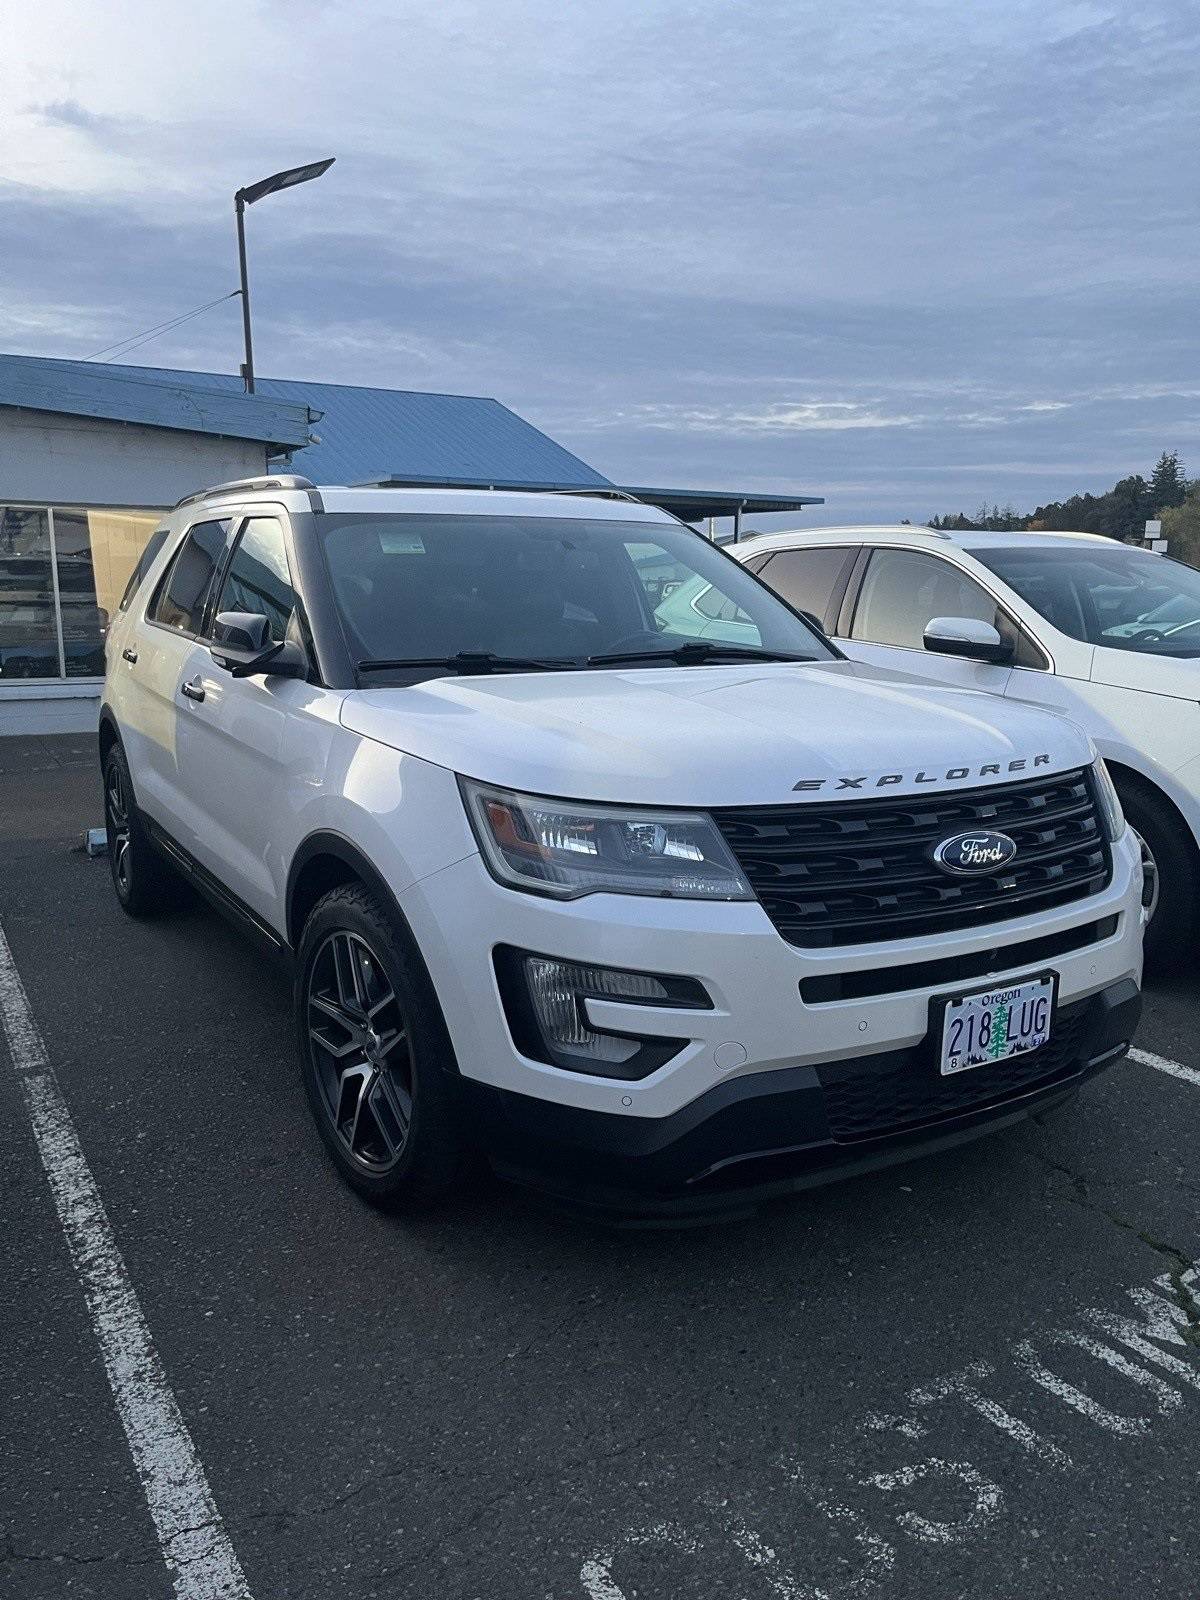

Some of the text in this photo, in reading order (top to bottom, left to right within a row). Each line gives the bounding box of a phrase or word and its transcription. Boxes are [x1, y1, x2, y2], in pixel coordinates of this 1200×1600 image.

[791, 753, 1050, 792] EXPLORER
[959, 837, 1004, 865] Ford
[981, 988, 1021, 1007] Oregon
[948, 996, 1048, 1059] 218 LUG
[950, 1057, 958, 1068] 8
